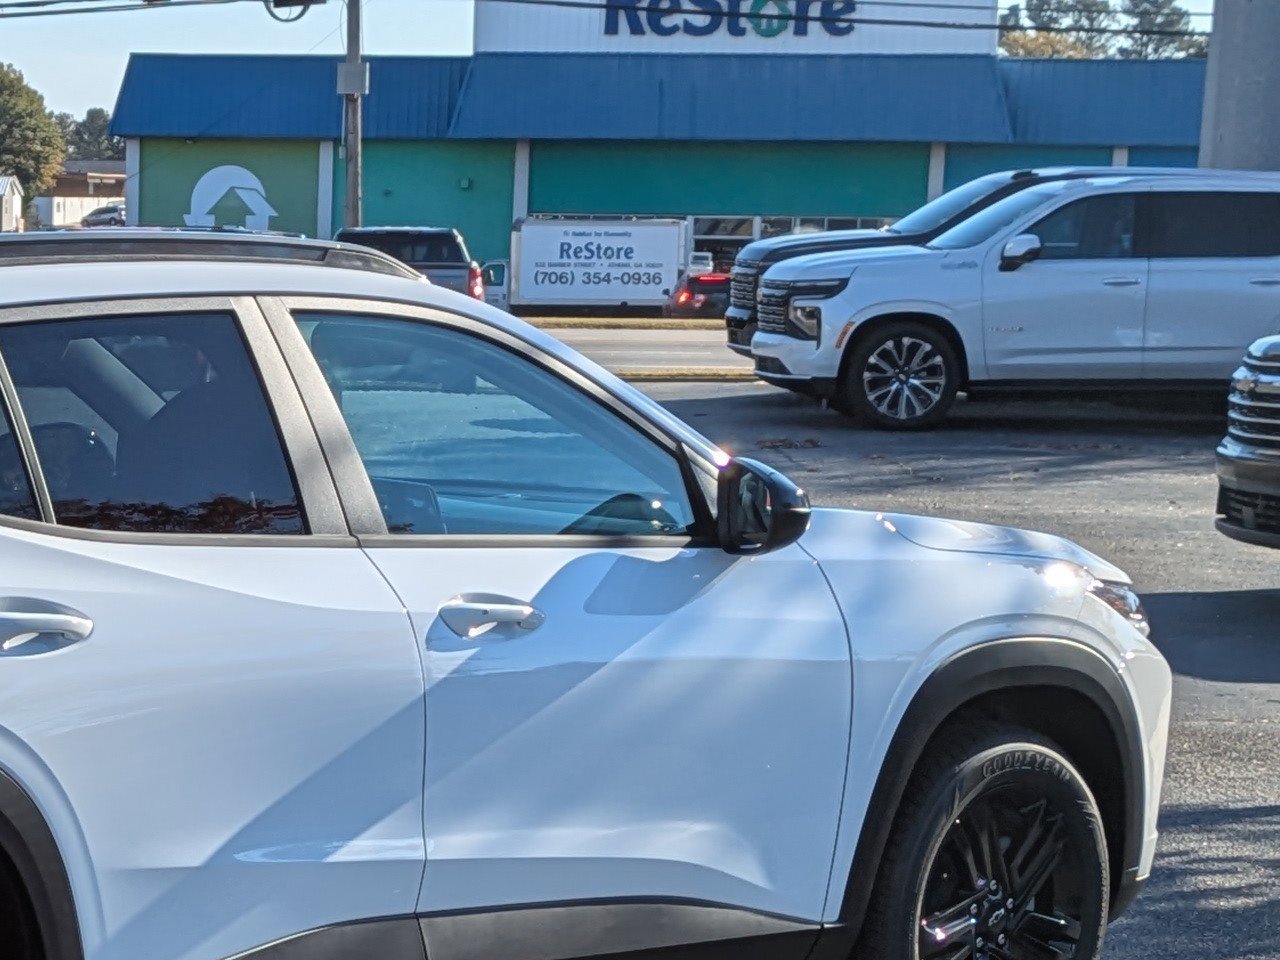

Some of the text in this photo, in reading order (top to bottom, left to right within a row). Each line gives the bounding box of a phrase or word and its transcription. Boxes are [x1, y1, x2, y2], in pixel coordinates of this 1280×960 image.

[604, 0, 856, 38] ReStore
[559, 241, 634, 260] ReStore
[534, 270, 663, 286] (706) 354-0936
